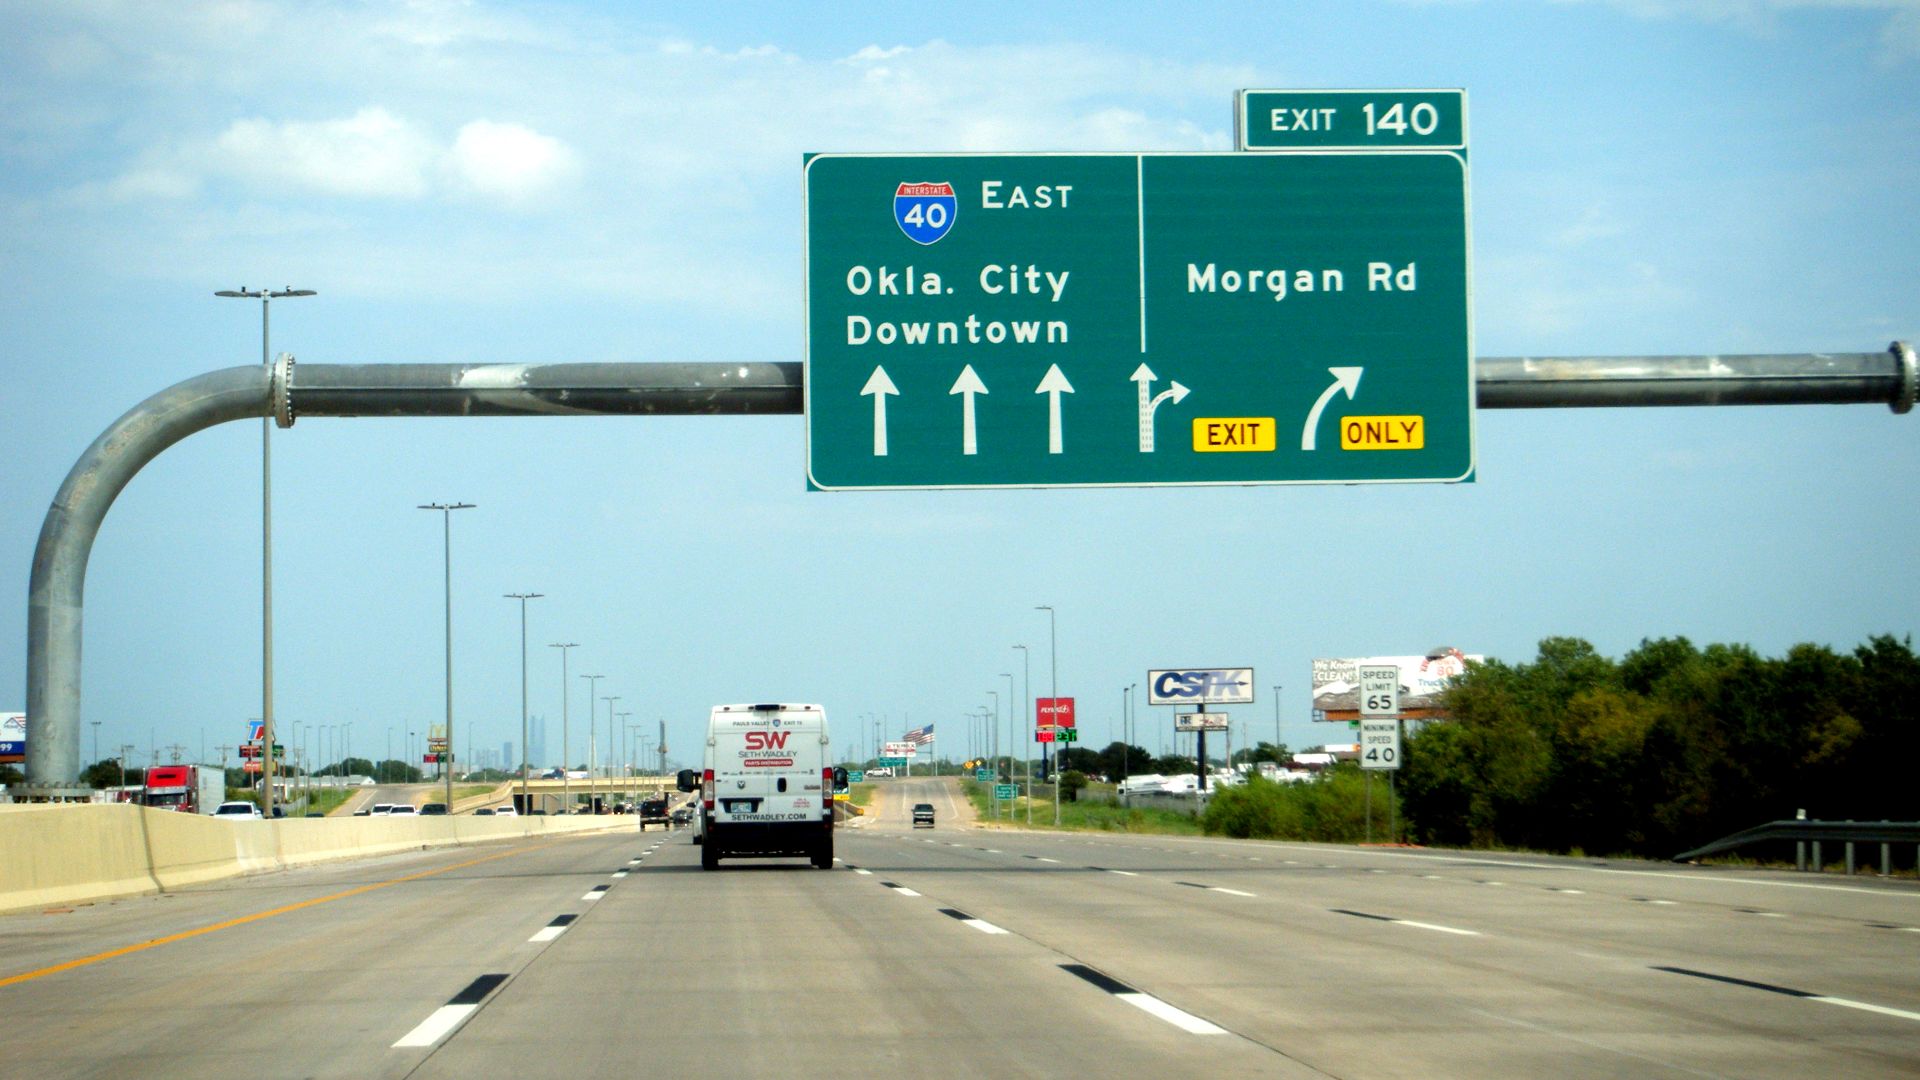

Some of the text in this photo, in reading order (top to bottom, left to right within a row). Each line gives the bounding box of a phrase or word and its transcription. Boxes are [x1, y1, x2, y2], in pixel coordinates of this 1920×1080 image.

[1271, 103, 1438, 136] EXIT 140
[903, 186, 946, 195] INTERSTATE
[982, 180, 1073, 209] EAST
[904, 203, 947, 228] 40
[847, 264, 1069, 302] Okla. City
[1187, 262, 1416, 302] Morgan Rd
[847, 314, 1068, 345] Downtown
[1207, 424, 1260, 446] EXIT
[1348, 422, 1417, 444] ONLY
[1363, 671, 1395, 680] SPEED
[1366, 683, 1391, 691] LIMIT
[1367, 695, 1392, 710] 65
[745, 731, 792, 750] SW
[1367, 736, 1391, 744] SPEED
[761, 750, 798, 758] WADLEY
[1365, 748, 1395, 762] 40
[731, 813, 807, 821] SETHWADLEY.COM
